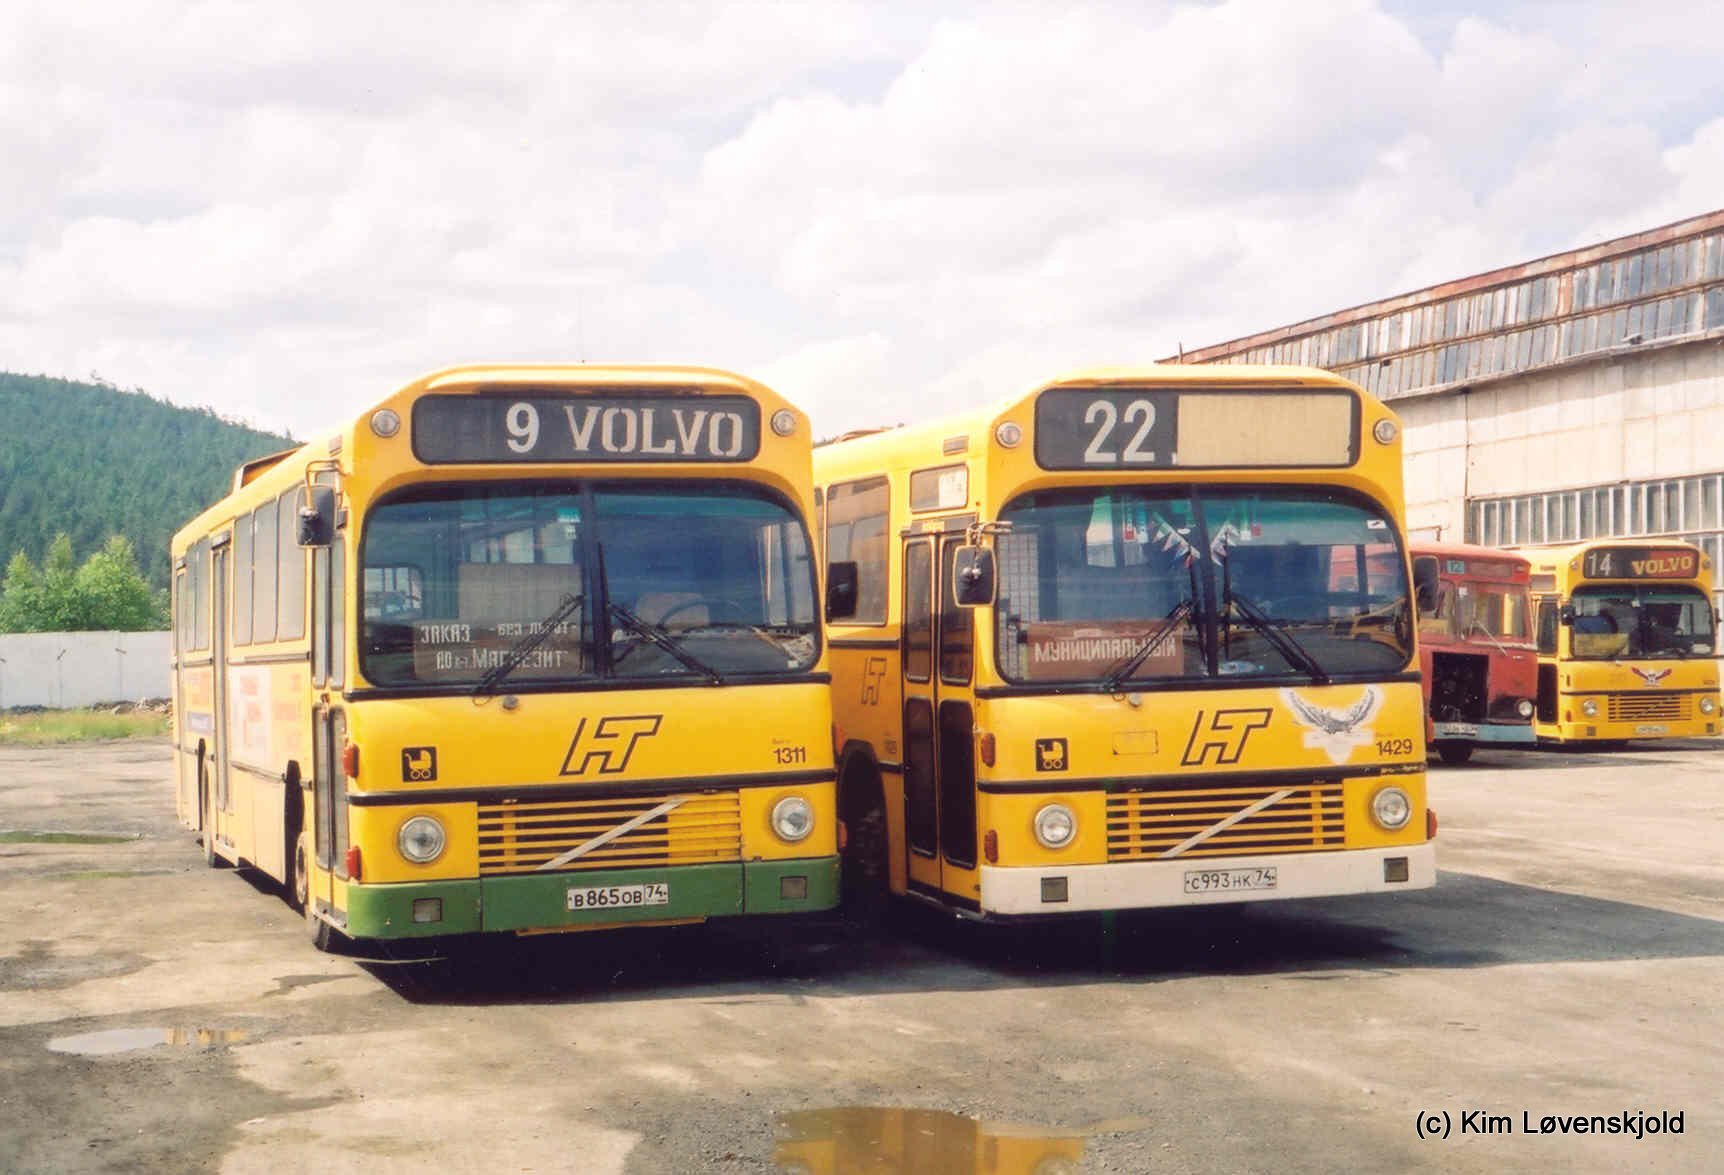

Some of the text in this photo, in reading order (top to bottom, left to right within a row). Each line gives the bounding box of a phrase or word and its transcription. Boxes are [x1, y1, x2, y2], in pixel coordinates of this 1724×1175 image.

[506, 402, 744, 457] 9 VOLVO
[1083, 399, 1156, 463] 22
[1588, 552, 1693, 577] 14 VOLVO
[420, 623, 471, 644] ЗАКАЗ
[773, 746, 806, 764] 1311
[1376, 738, 1413, 756] 1429
